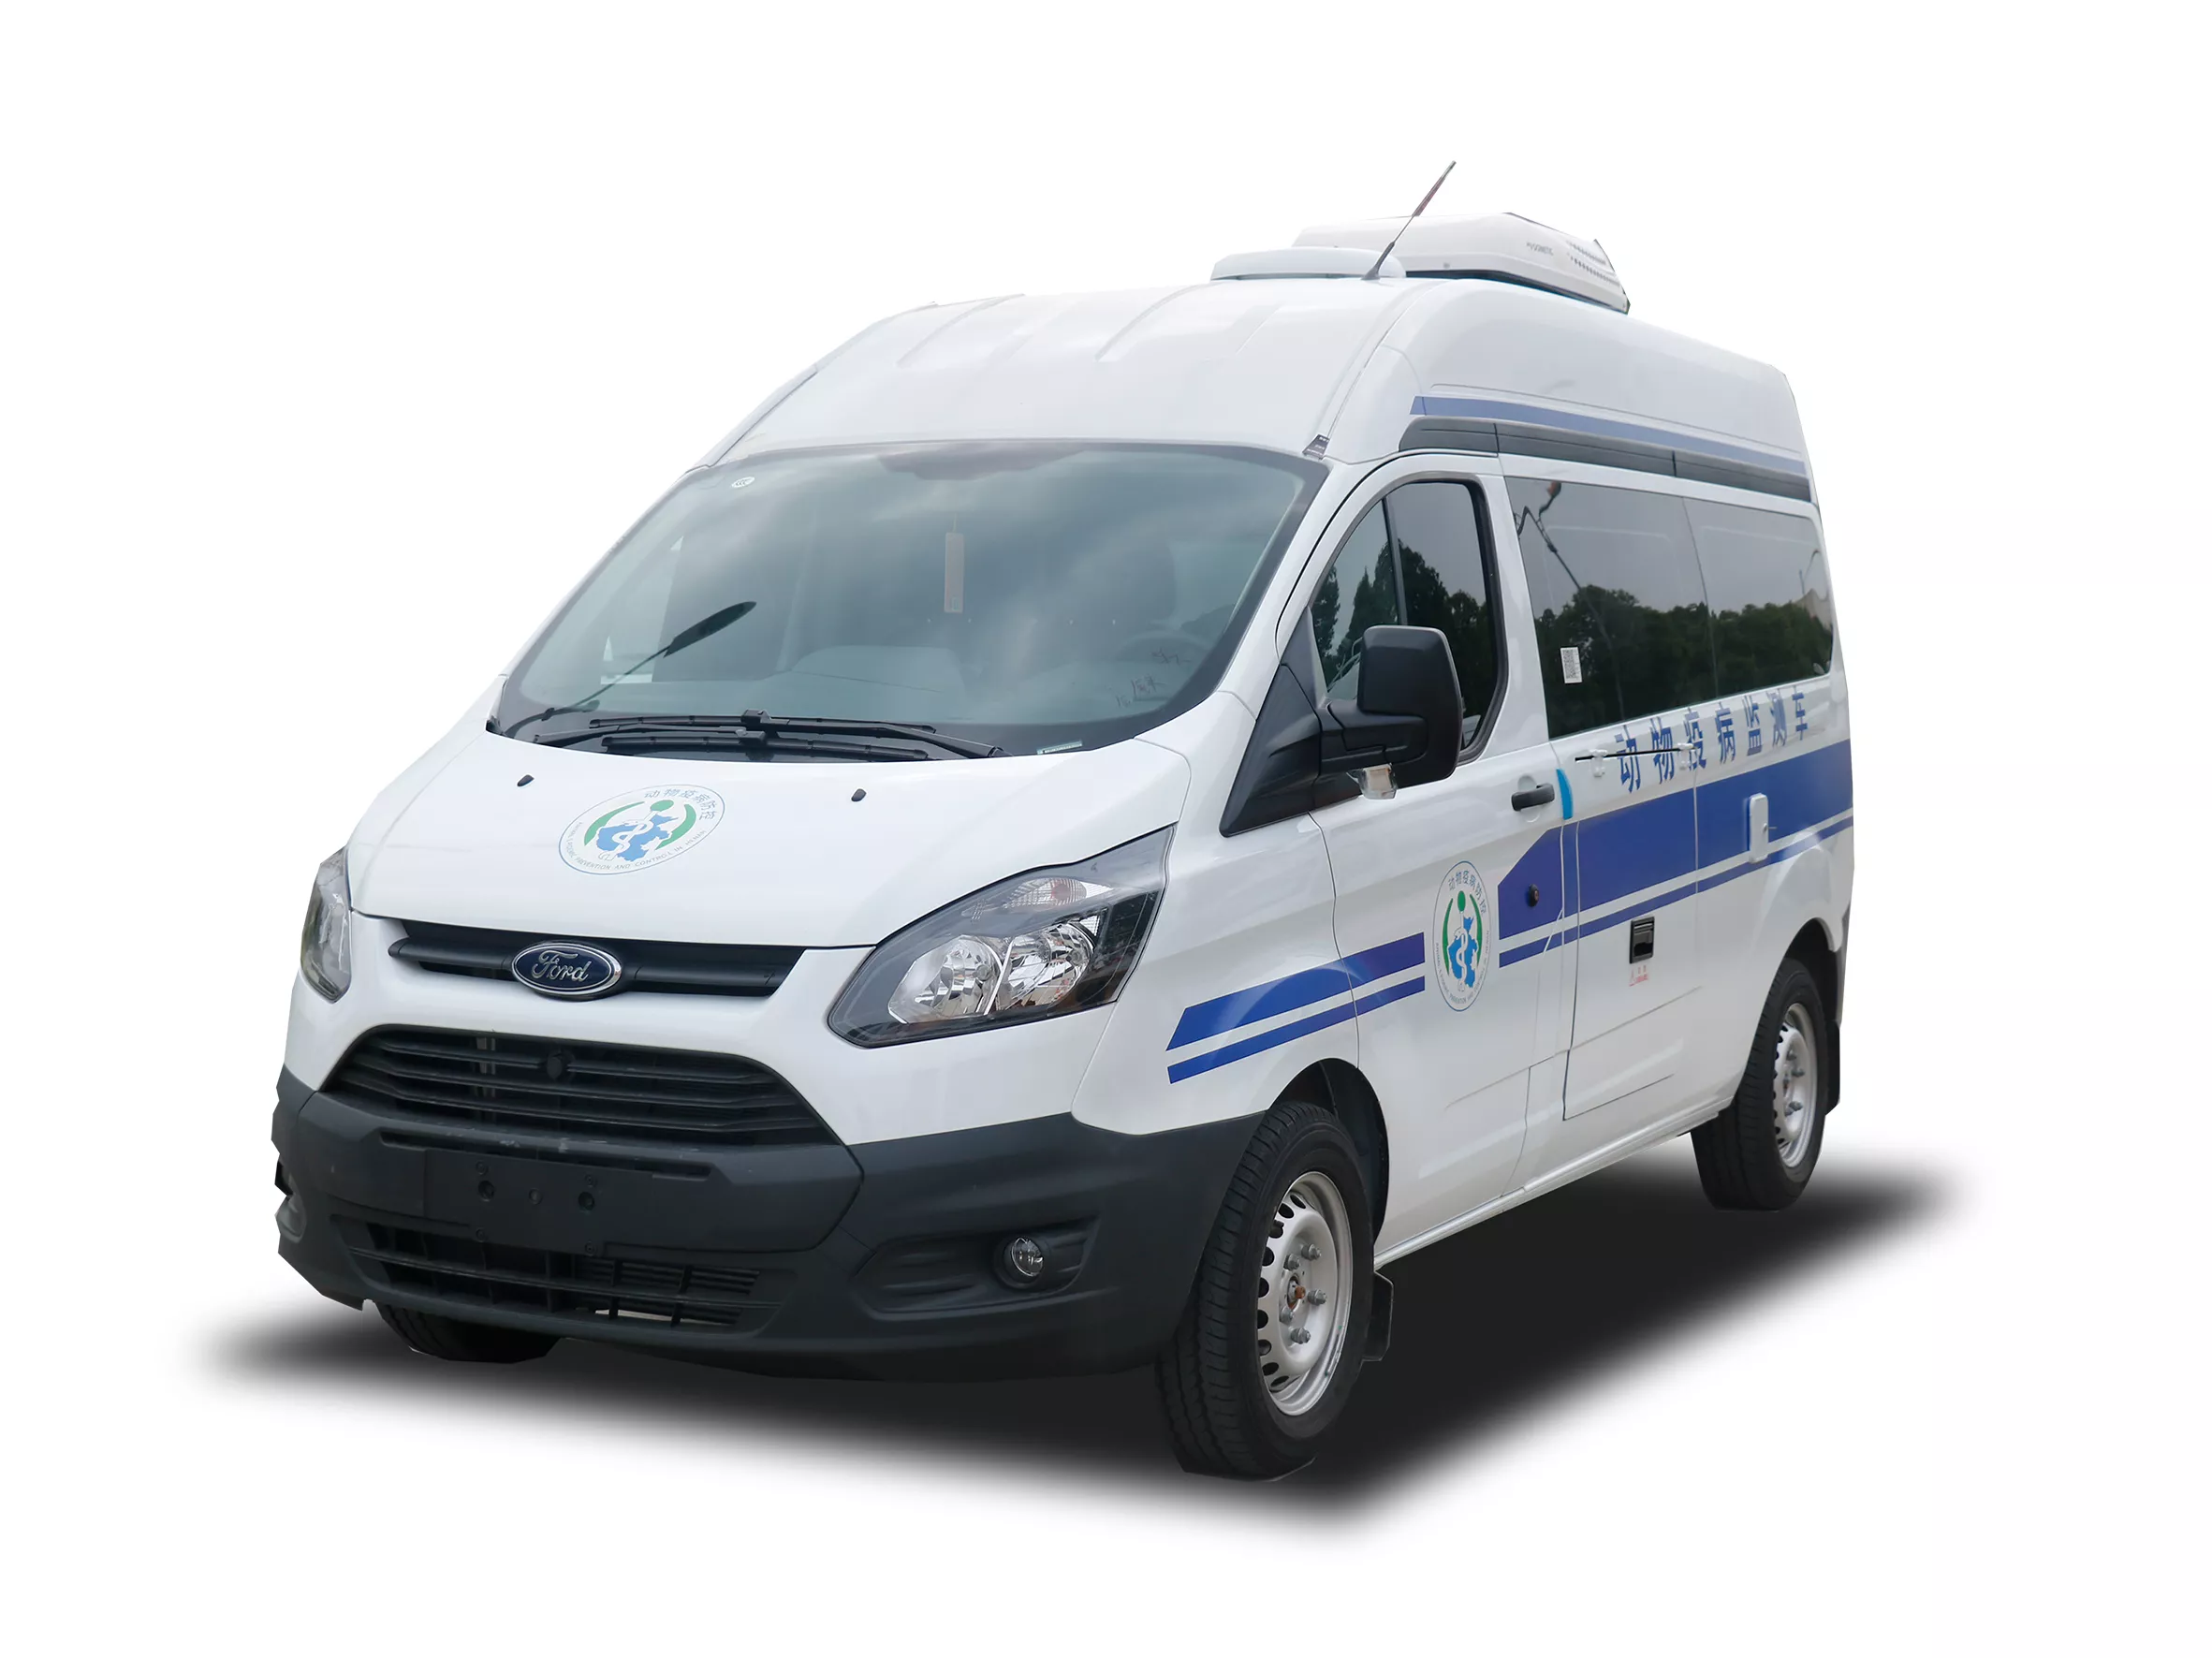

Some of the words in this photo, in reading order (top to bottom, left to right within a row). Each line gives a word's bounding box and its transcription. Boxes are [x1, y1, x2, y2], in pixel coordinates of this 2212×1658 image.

[1614, 684, 1808, 794] 动物疫病监测车
[532, 949, 592, 982] Ford
